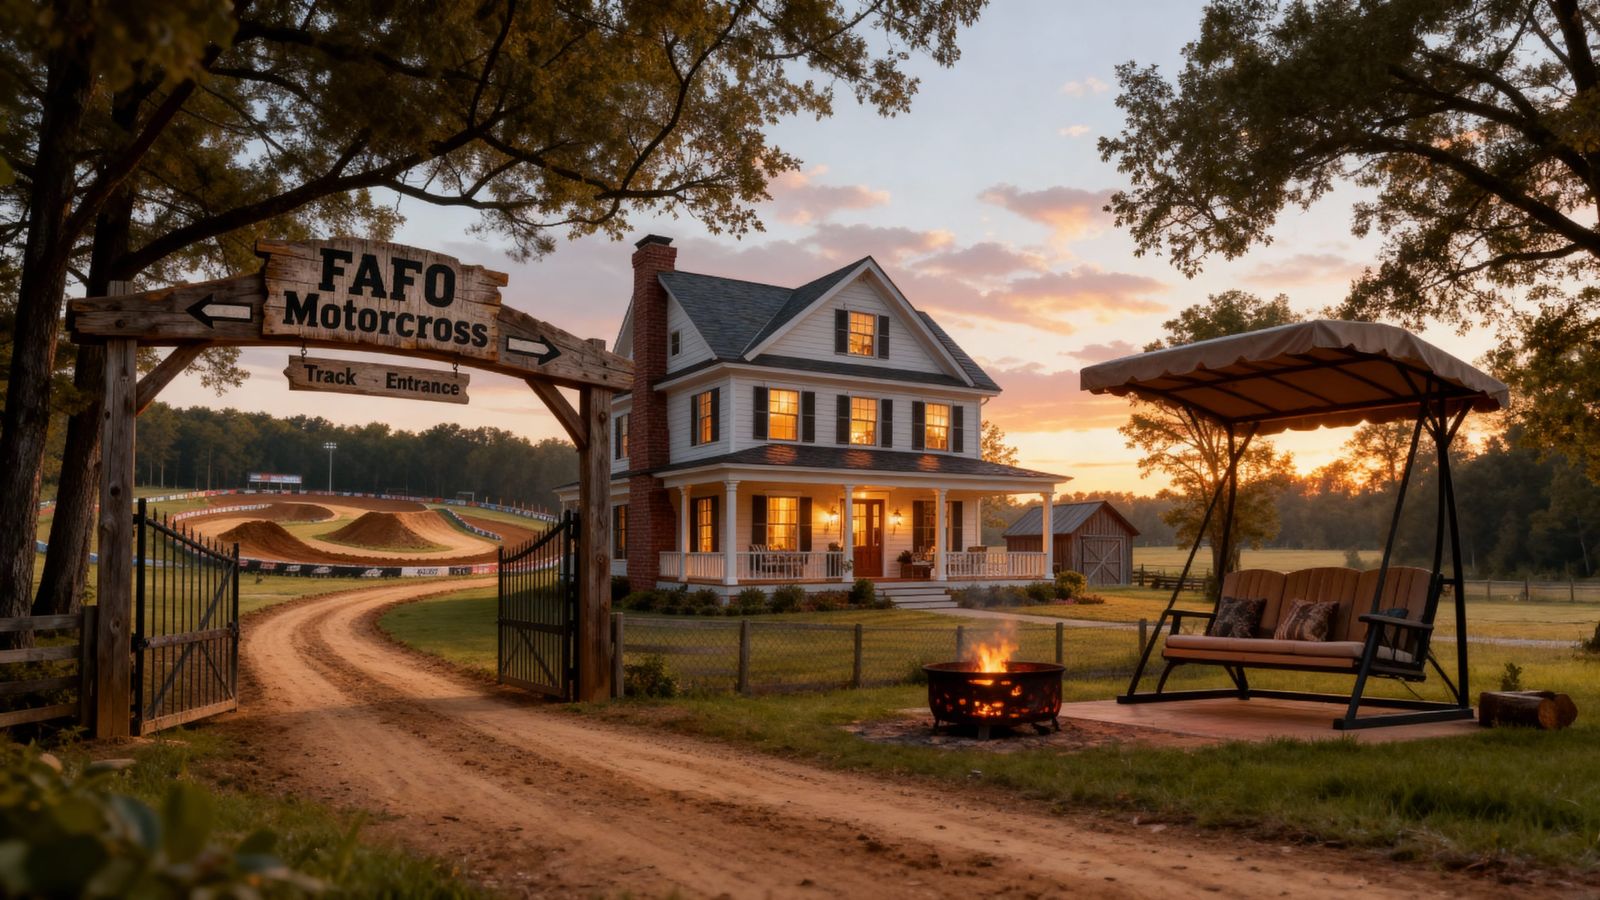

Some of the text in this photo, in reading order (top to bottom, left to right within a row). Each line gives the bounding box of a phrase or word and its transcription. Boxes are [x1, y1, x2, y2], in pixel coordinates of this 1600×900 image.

[318, 247, 456, 308] FAFO
[282, 290, 488, 348] Motorcross
[304, 363, 460, 396] Track Entrance
